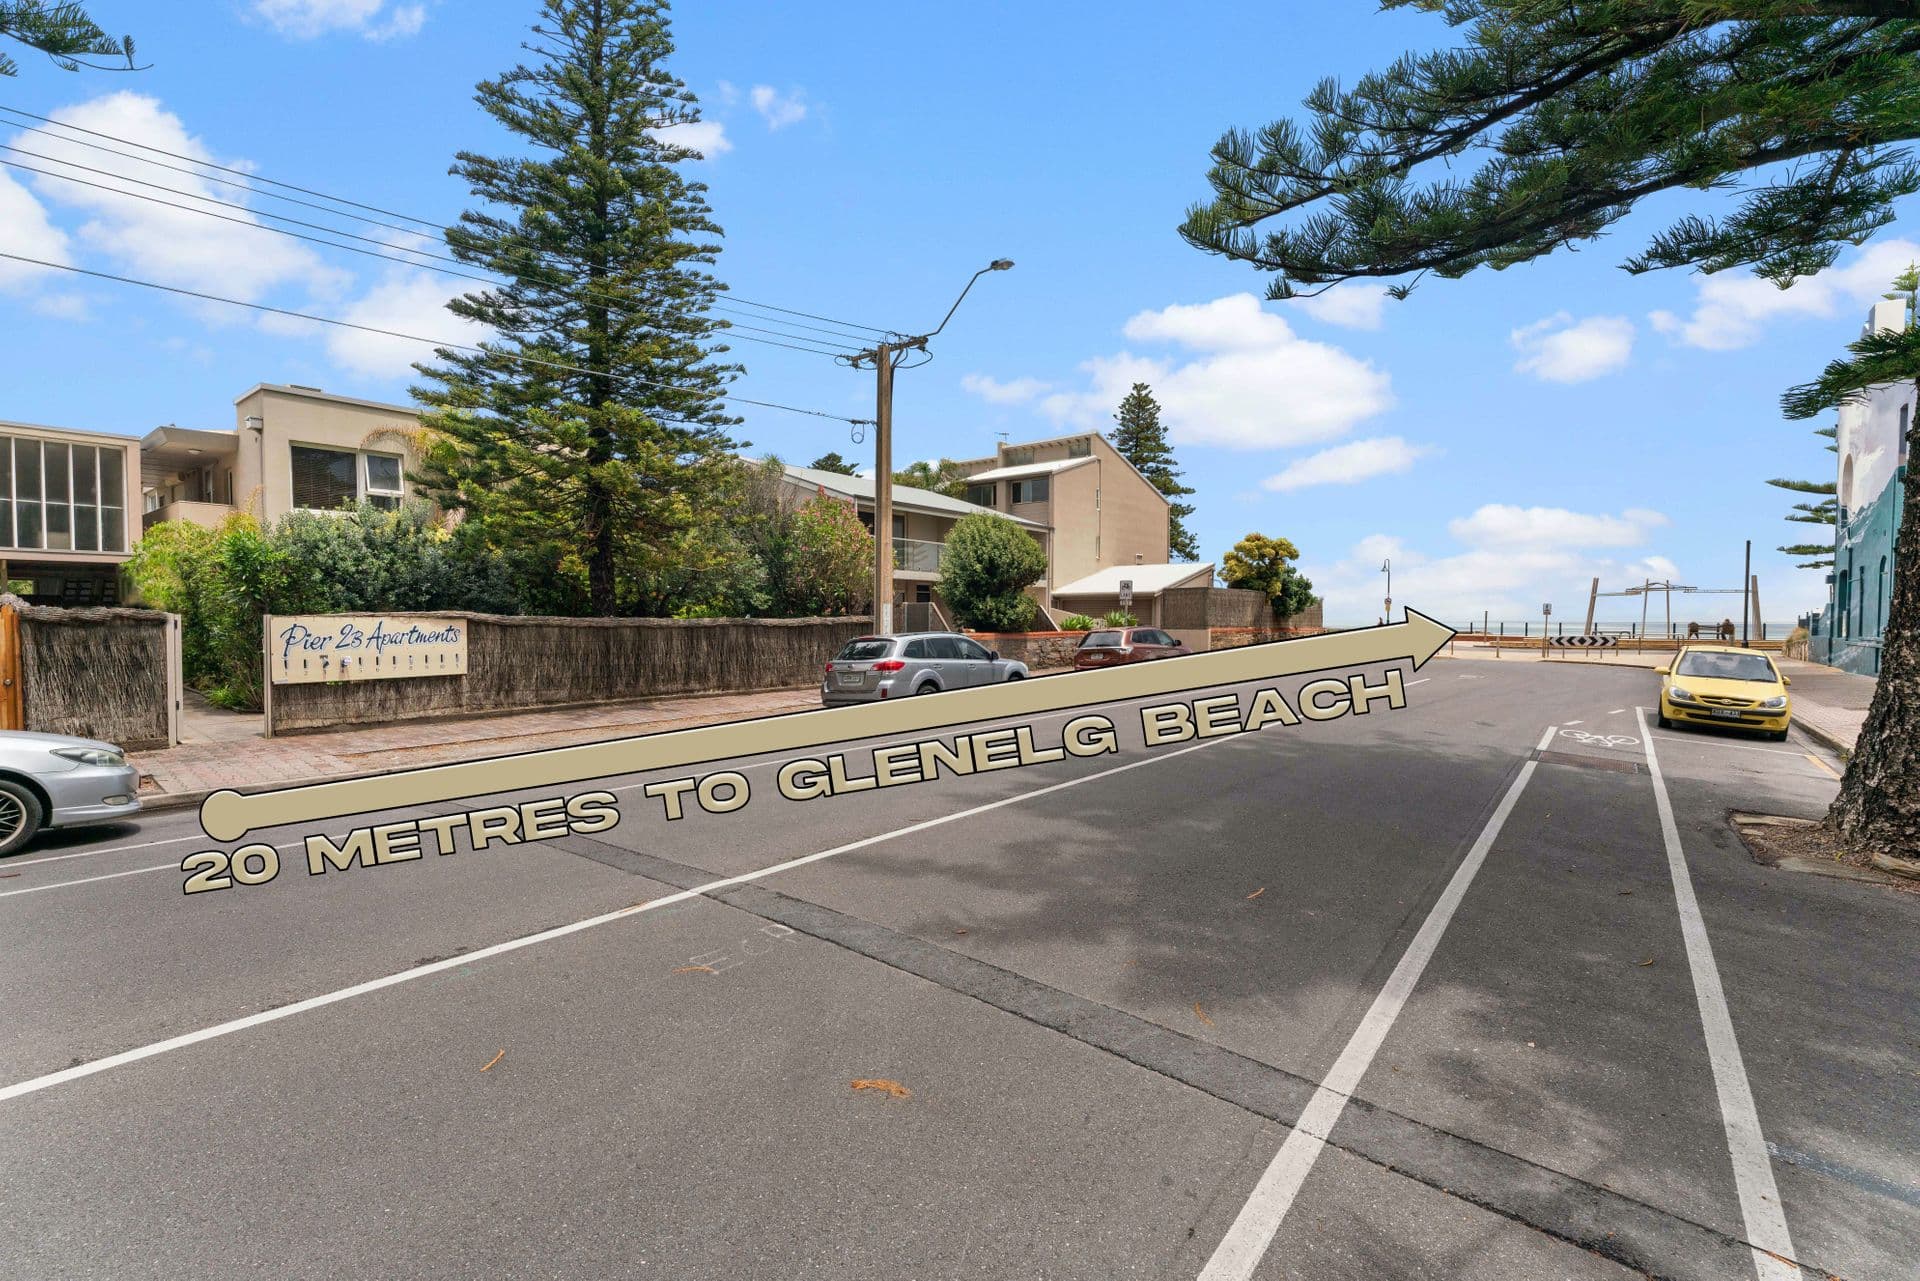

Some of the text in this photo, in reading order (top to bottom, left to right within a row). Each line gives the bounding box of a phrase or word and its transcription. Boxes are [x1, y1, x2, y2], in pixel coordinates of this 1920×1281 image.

[280, 621, 460, 656] Pier 23 Apartments
